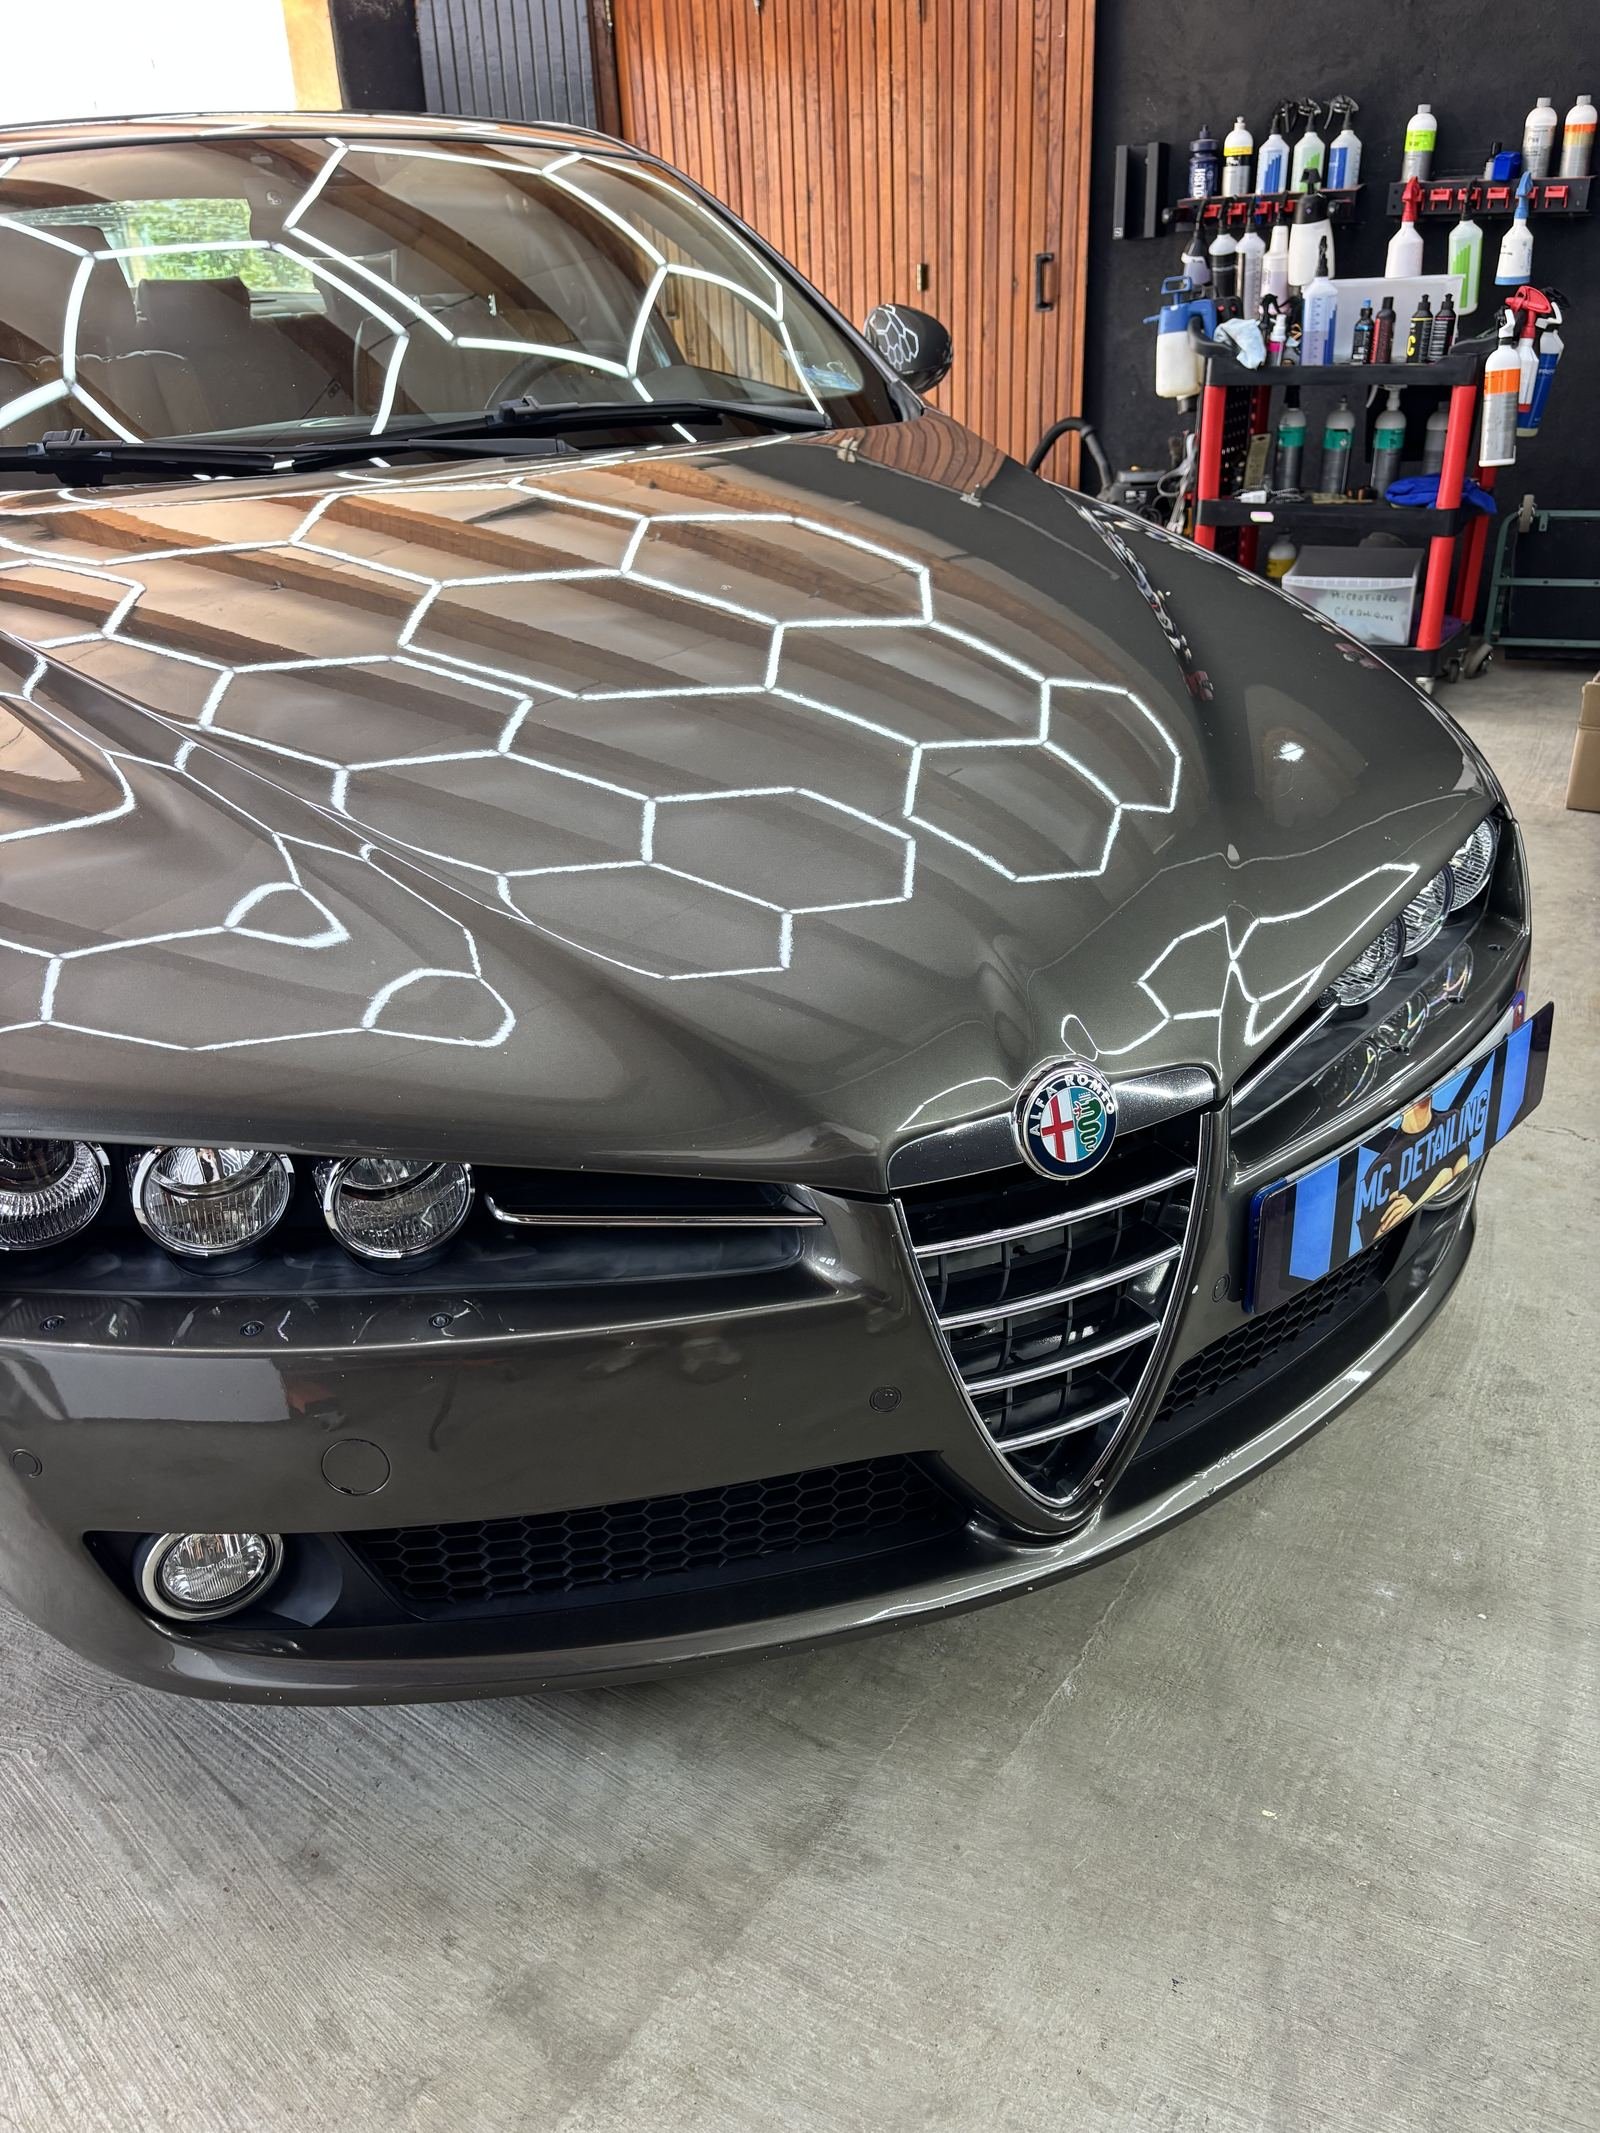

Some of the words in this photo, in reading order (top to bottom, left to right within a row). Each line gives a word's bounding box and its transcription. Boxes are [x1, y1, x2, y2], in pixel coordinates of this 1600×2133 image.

[1192, 168, 1206, 198] OLISH
[1029, 1086, 1058, 1137] ALFA
[1064, 1074, 1115, 1115] ROMEO
[1358, 1163, 1392, 1220] MC
[1398, 1090, 1488, 1190] DETAILING
